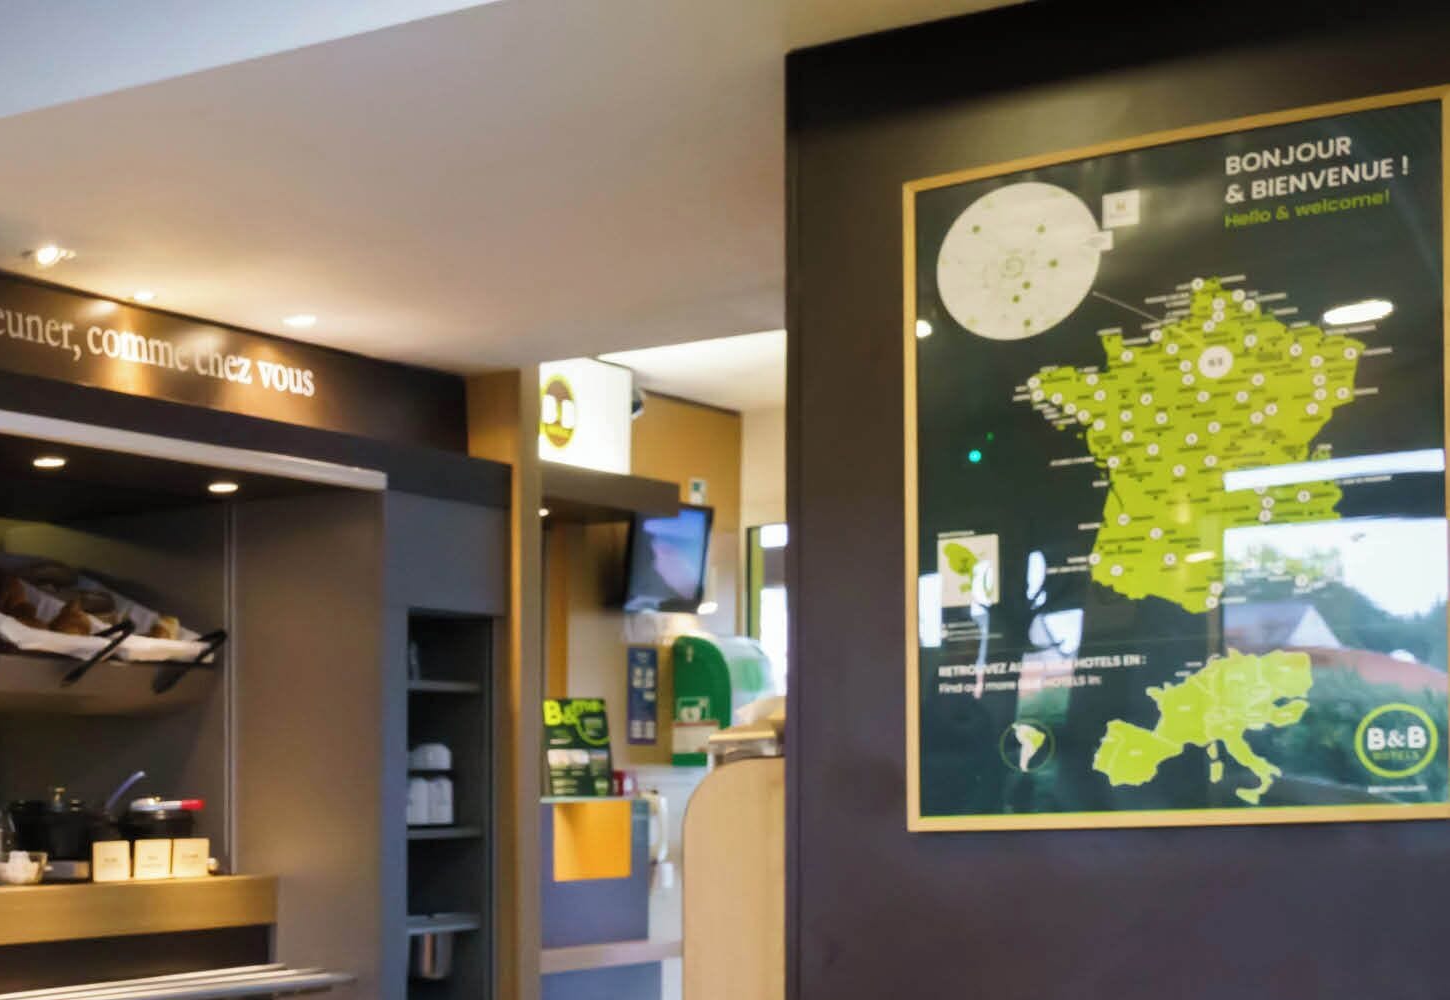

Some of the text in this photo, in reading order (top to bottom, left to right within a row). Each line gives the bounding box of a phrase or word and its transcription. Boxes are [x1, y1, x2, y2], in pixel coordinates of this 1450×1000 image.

[1225, 136, 1352, 175] BONJOUR
[1225, 184, 1246, 204] &
[1251, 158, 1395, 199] BIENVENUE
[1224, 188, 1390, 228] Hello & welcome!
[87, 326, 190, 371] comme
[193, 342, 253, 385] chez
[257, 360, 315, 398] vous
[1367, 726, 1427, 751] B&B
